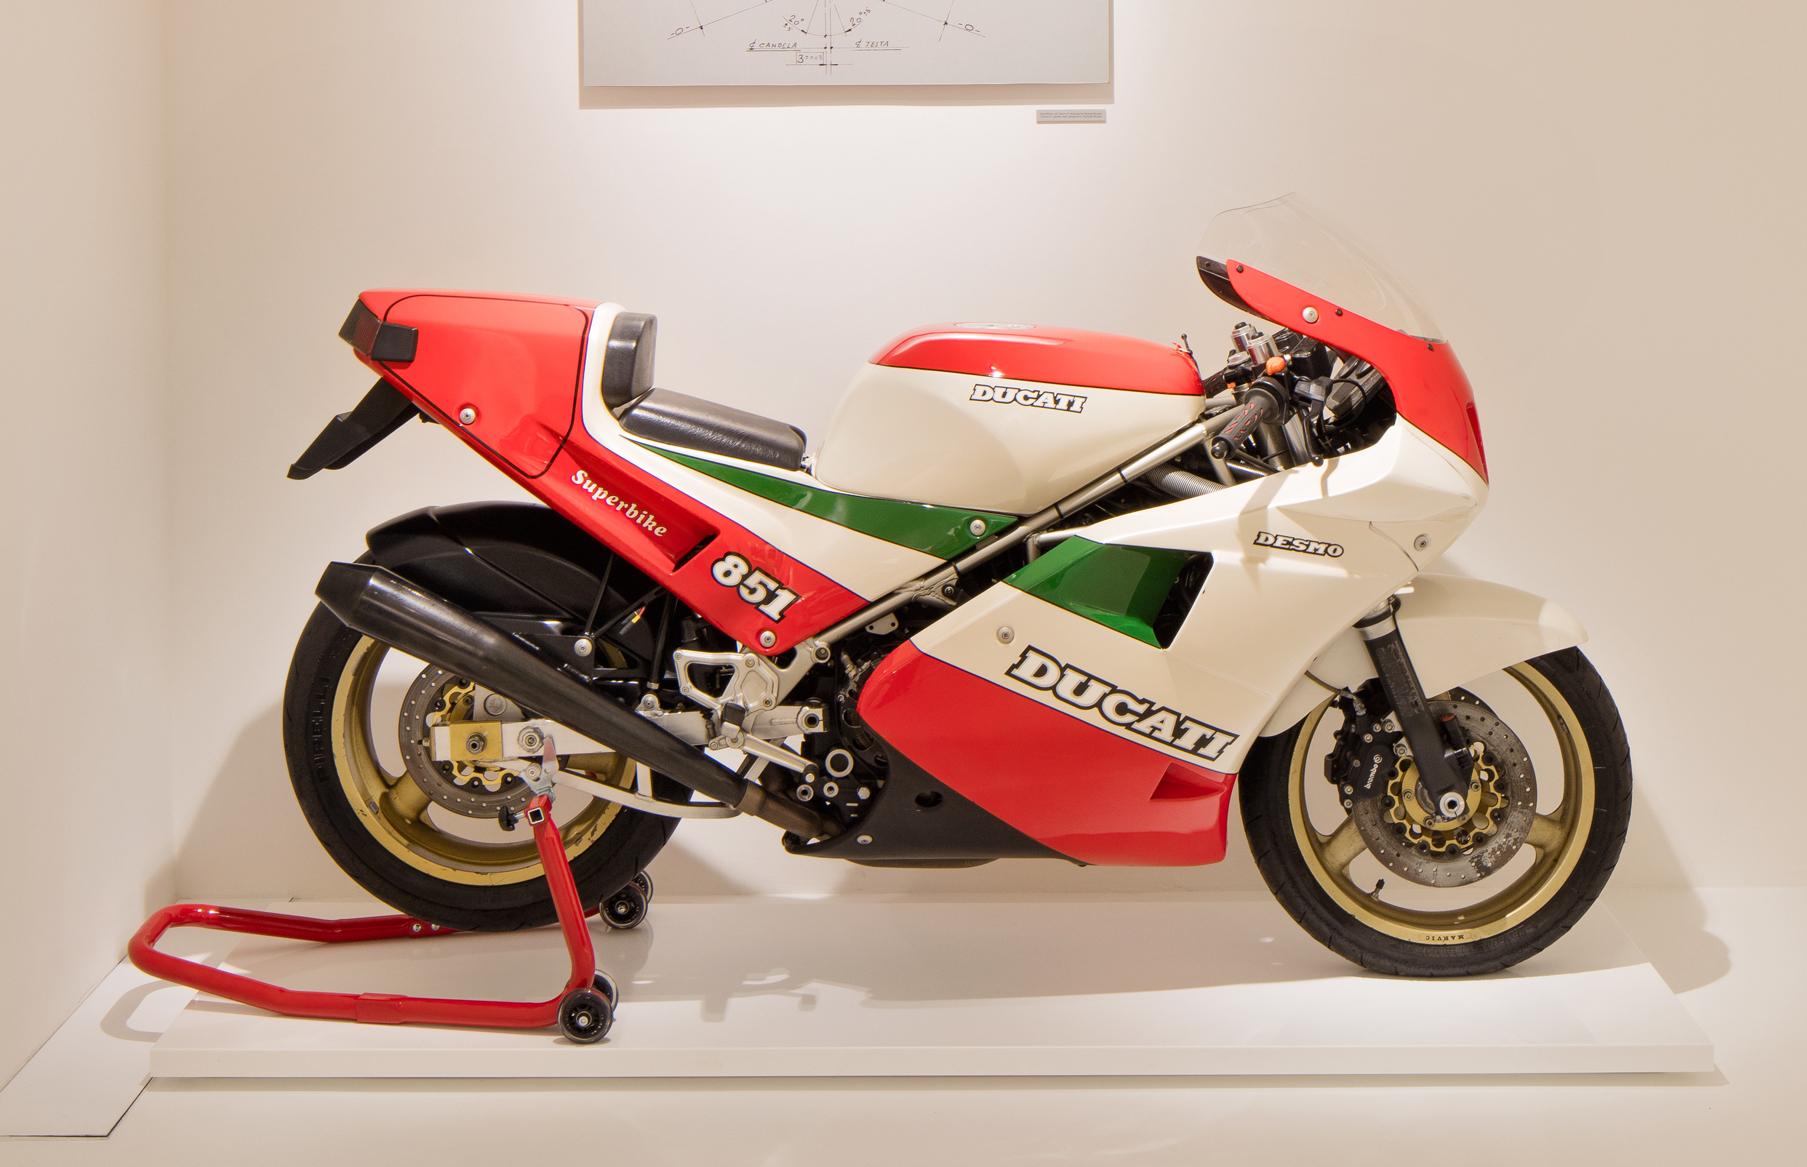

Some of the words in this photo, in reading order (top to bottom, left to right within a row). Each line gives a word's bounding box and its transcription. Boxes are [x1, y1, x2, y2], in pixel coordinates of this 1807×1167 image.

[970, 383, 1087, 413] DUCATI
[571, 469, 668, 537] Superbike
[1253, 530, 1344, 558] DESMO
[711, 551, 801, 622] 851
[1004, 644, 1240, 761] DUCATI
[1363, 763, 1379, 790] brembo
